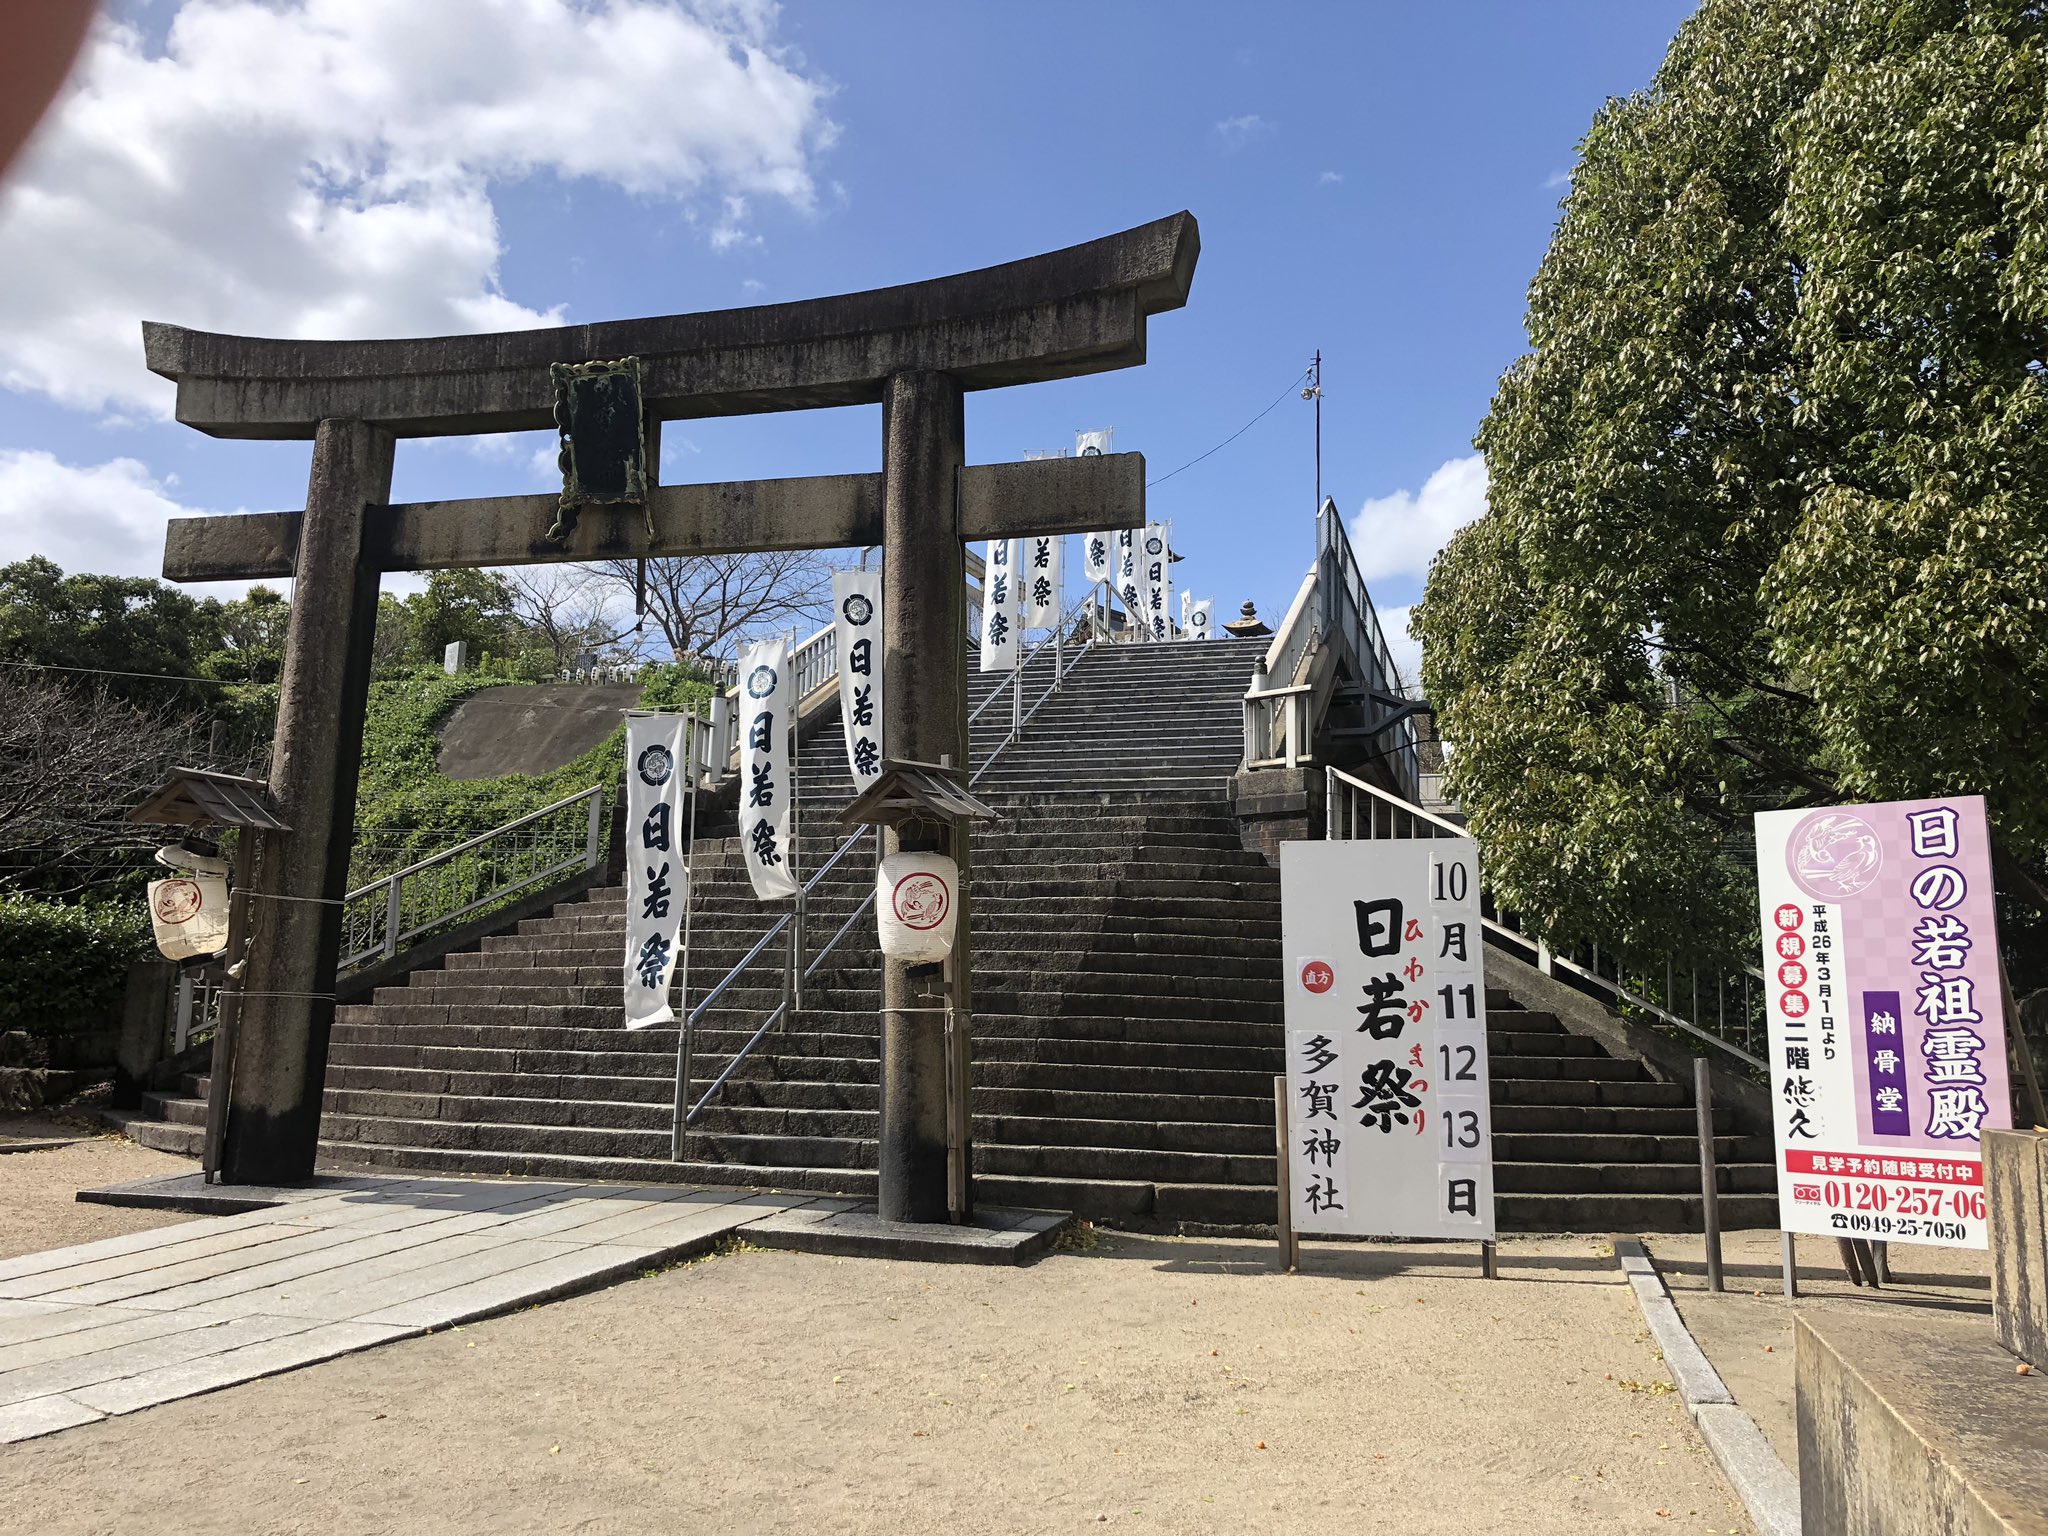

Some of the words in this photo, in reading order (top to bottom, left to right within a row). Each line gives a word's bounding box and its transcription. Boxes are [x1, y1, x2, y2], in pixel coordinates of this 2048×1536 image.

[988, 539, 1009, 646] 日若祭
[1033, 537, 1052, 607] 若祭
[1120, 529, 1138, 609] 日若祭
[1149, 562, 1165, 639] 日若祭
[849, 638, 881, 777] 日若祭
[748, 710, 782, 867] 日若祭
[635, 802, 672, 990] 日若祭
[1305, 969, 1331, 985] 直方
[1777, 907, 1806, 1015] 新規募集
[1812, 904, 1836, 1061] 平成26年3月1日より
[1906, 806, 1989, 1140] 日の若祖霊殿
[1351, 898, 1422, 1133] 日若祭
[1404, 918, 1430, 1136] ひわかまつり
[1870, 1010, 1904, 1113] 納骨堂
[1300, 1034, 1344, 1215] 多賀神社
[1811, 1155, 1974, 1181] 見学予約随時受付中
[1824, 1180, 1987, 1221] 0120-257-06
[1850, 1213, 1967, 1241] 0949-25-7050
